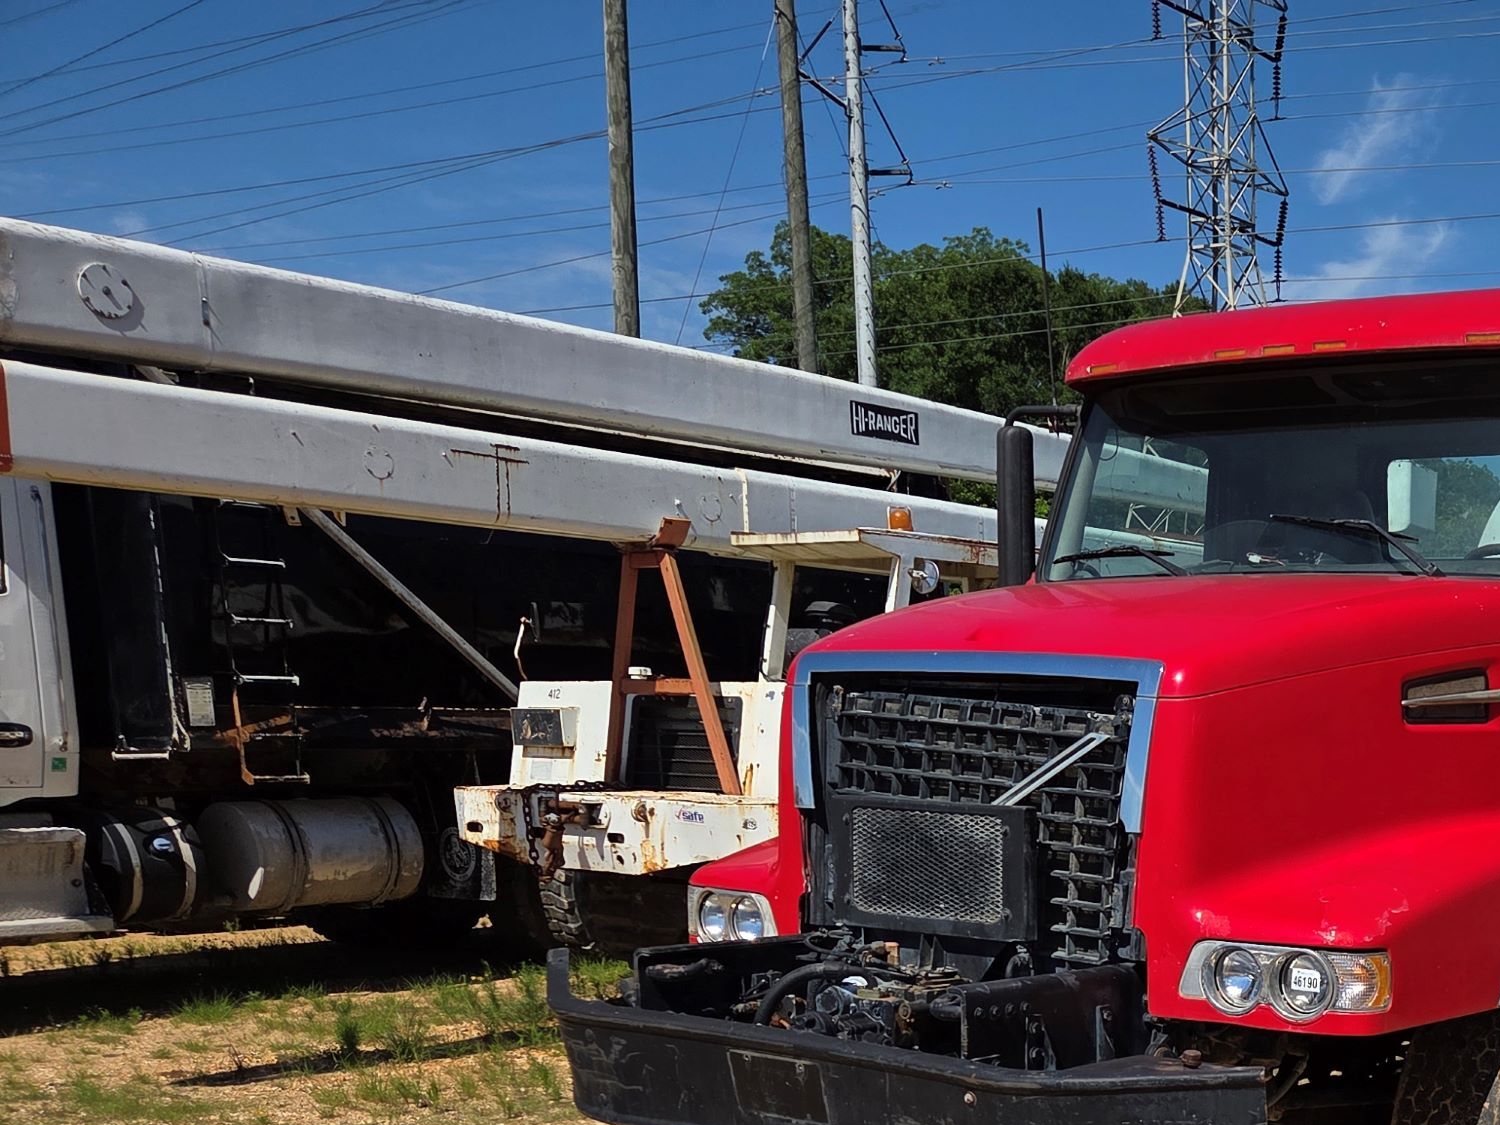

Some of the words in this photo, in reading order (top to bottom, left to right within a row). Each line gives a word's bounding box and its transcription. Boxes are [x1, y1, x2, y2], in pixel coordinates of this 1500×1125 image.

[852, 402, 917, 444] HI-RANGER
[547, 688, 561, 700] 412
[1293, 975, 1318, 989] 46190
